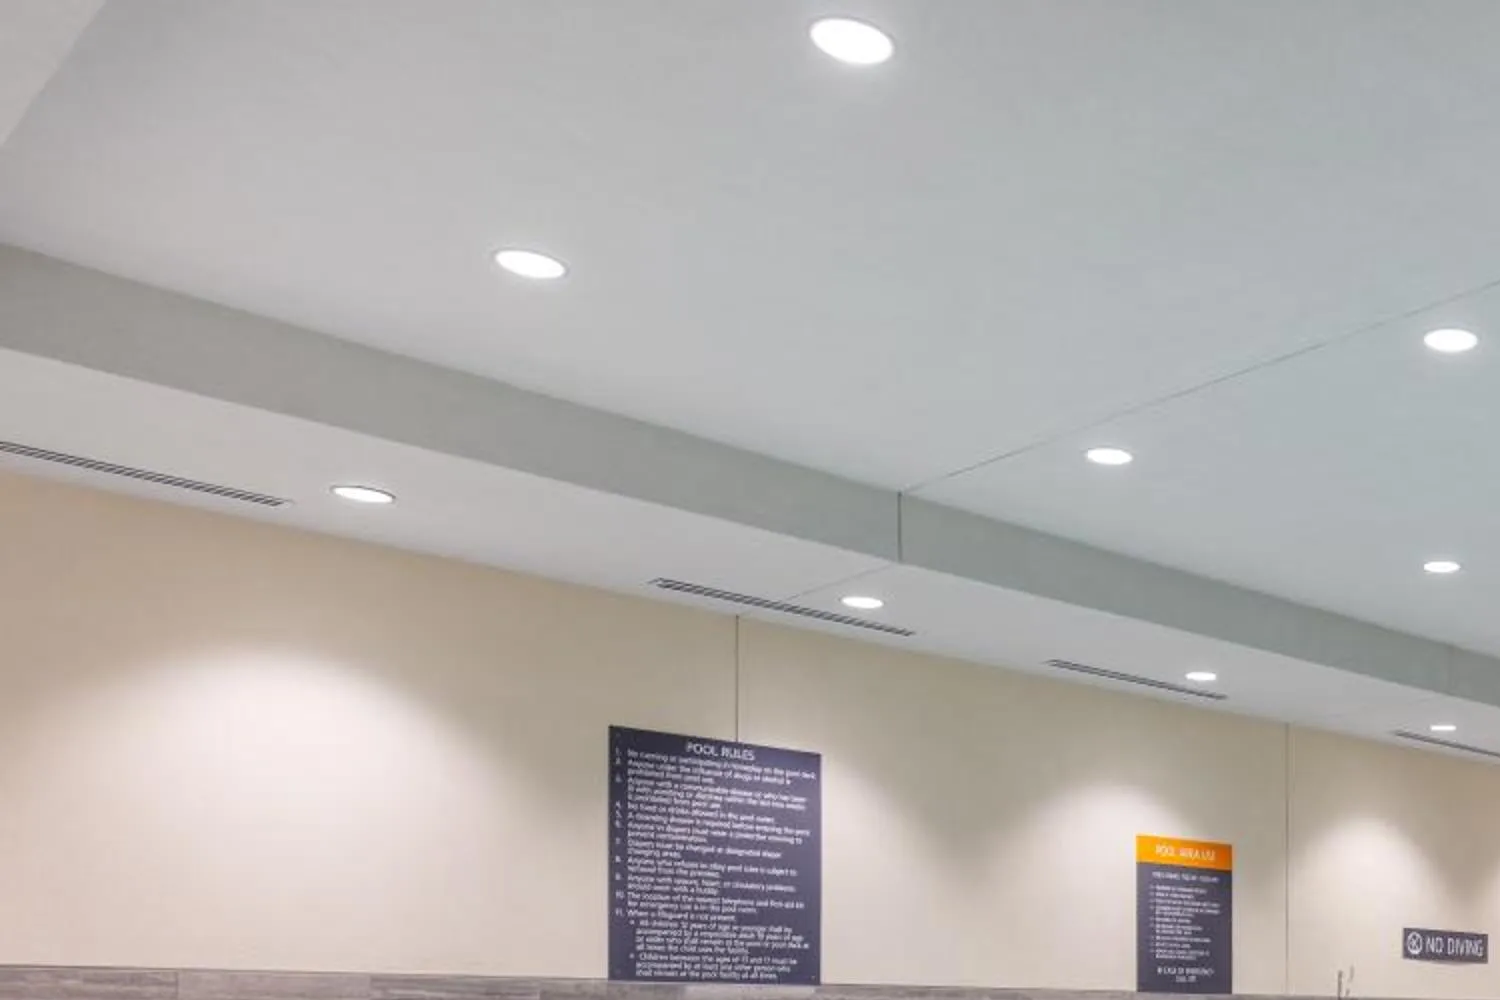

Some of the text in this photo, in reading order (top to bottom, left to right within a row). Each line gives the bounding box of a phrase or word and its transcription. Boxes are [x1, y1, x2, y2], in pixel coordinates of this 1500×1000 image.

[686, 742, 755, 761] POOL RULES
[1426, 936, 1485, 957] NO DIVING
